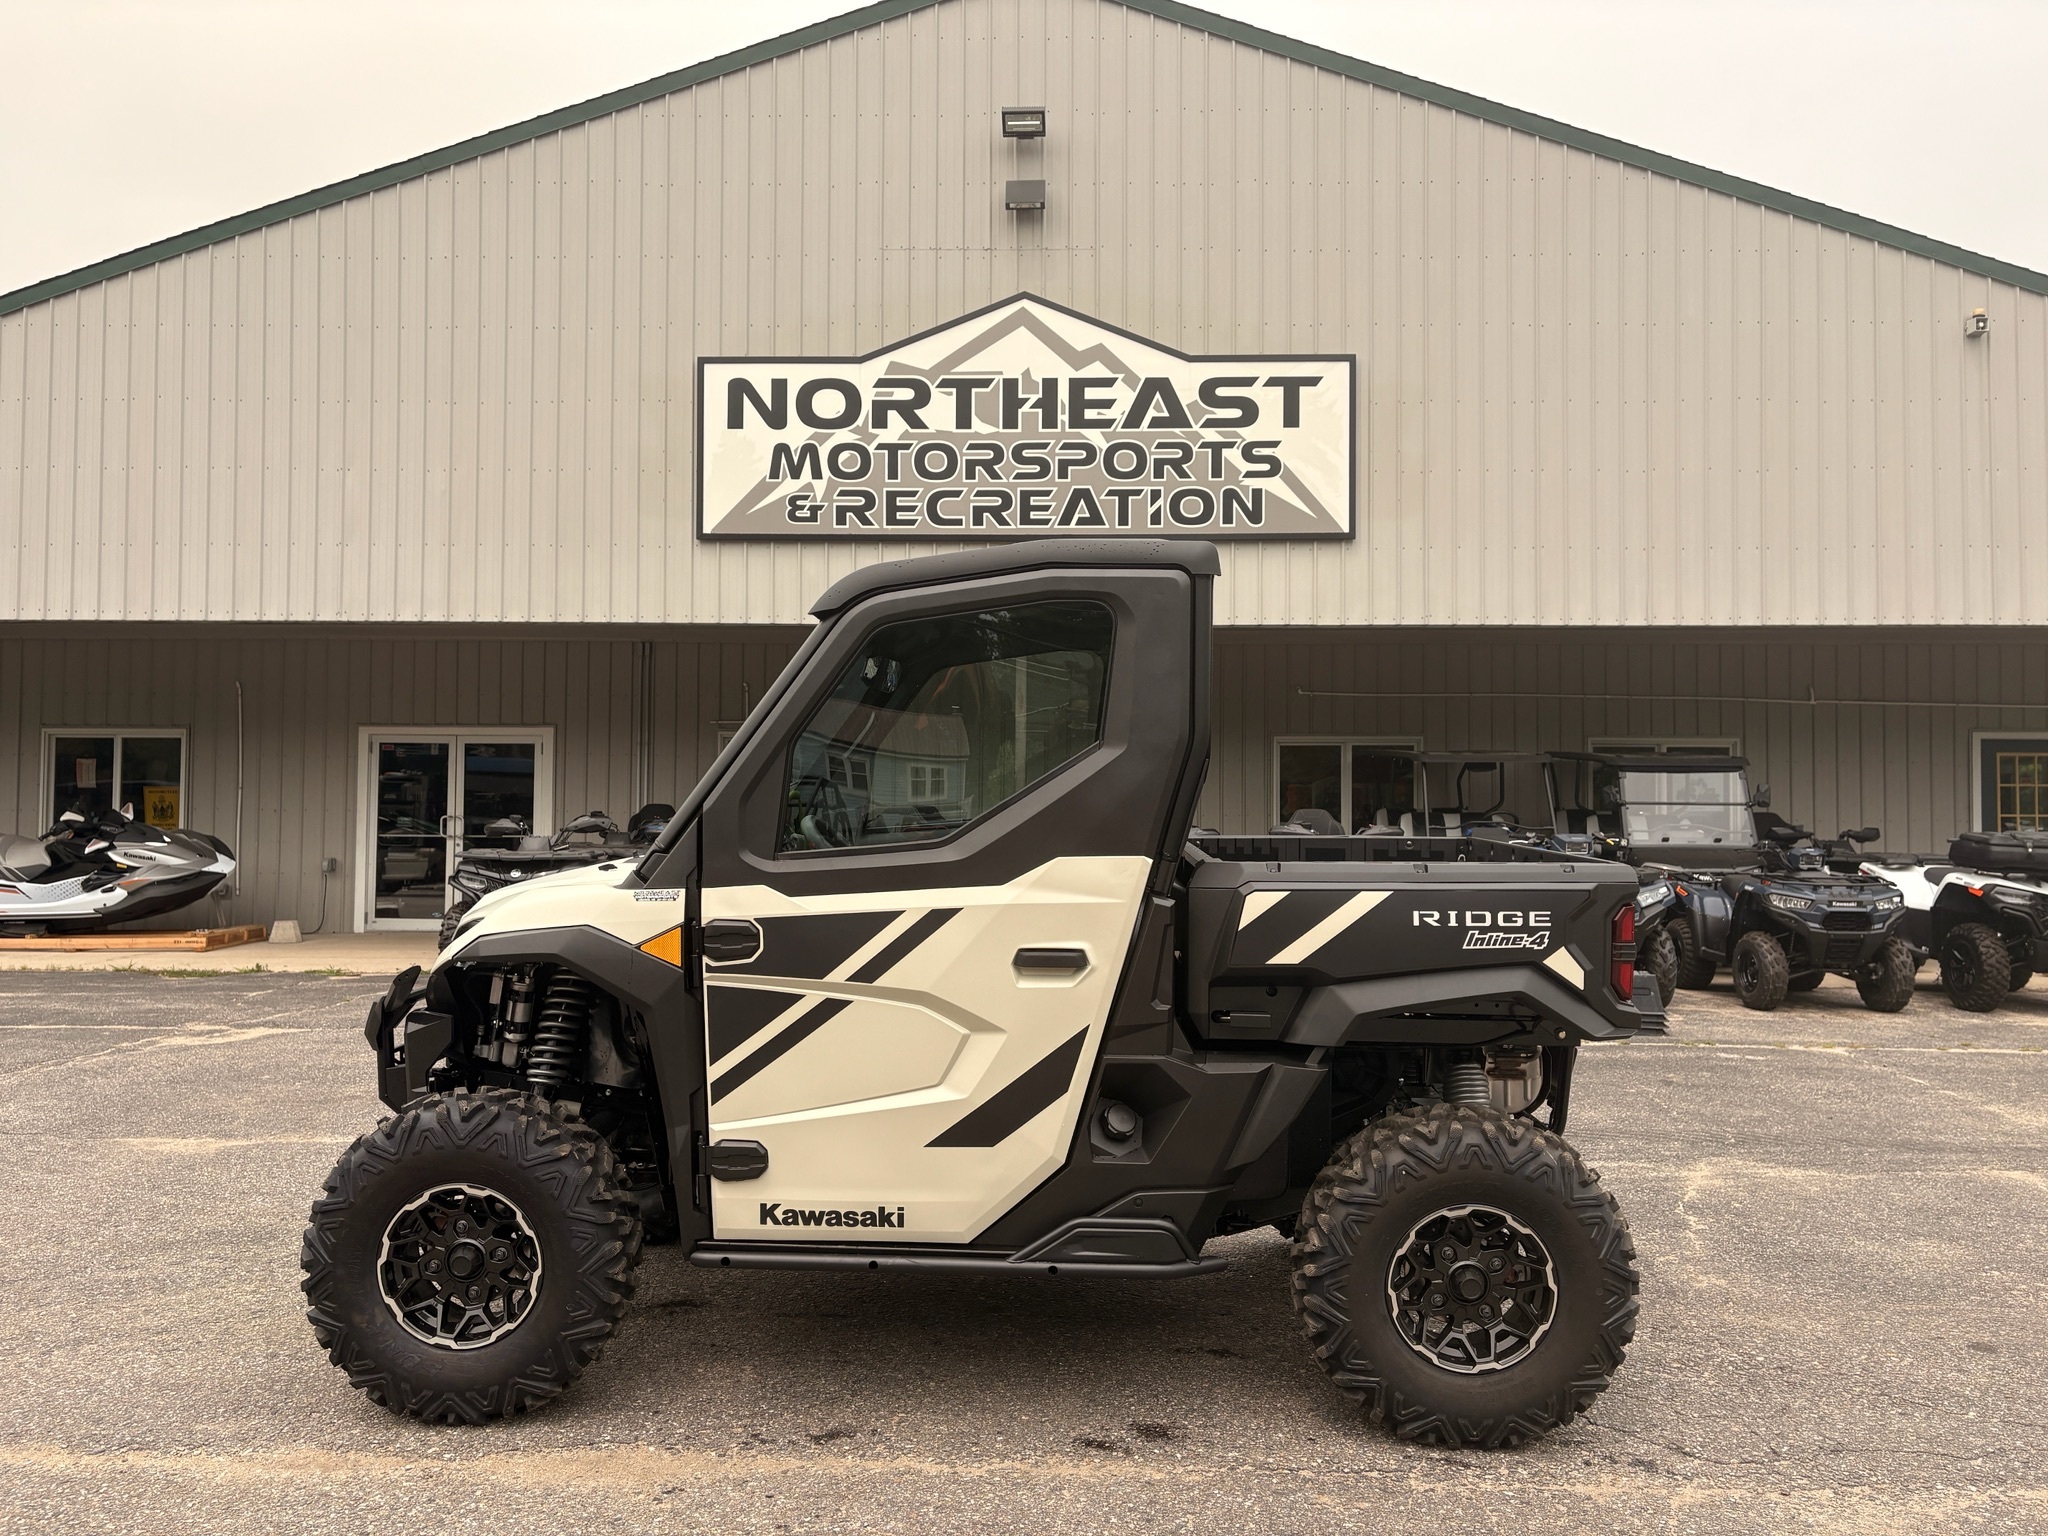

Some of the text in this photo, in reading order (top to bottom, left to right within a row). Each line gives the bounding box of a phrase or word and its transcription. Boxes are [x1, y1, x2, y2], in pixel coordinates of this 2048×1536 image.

[726, 375, 1324, 430] NORTHEAST
[767, 439, 1283, 481] MOTORSPORTS
[123, 851, 157, 862] Kawasaki
[1412, 910, 1552, 927] RIDGE
[1462, 930, 1550, 950] Inline-4
[759, 1203, 905, 1228] Kawasaki
